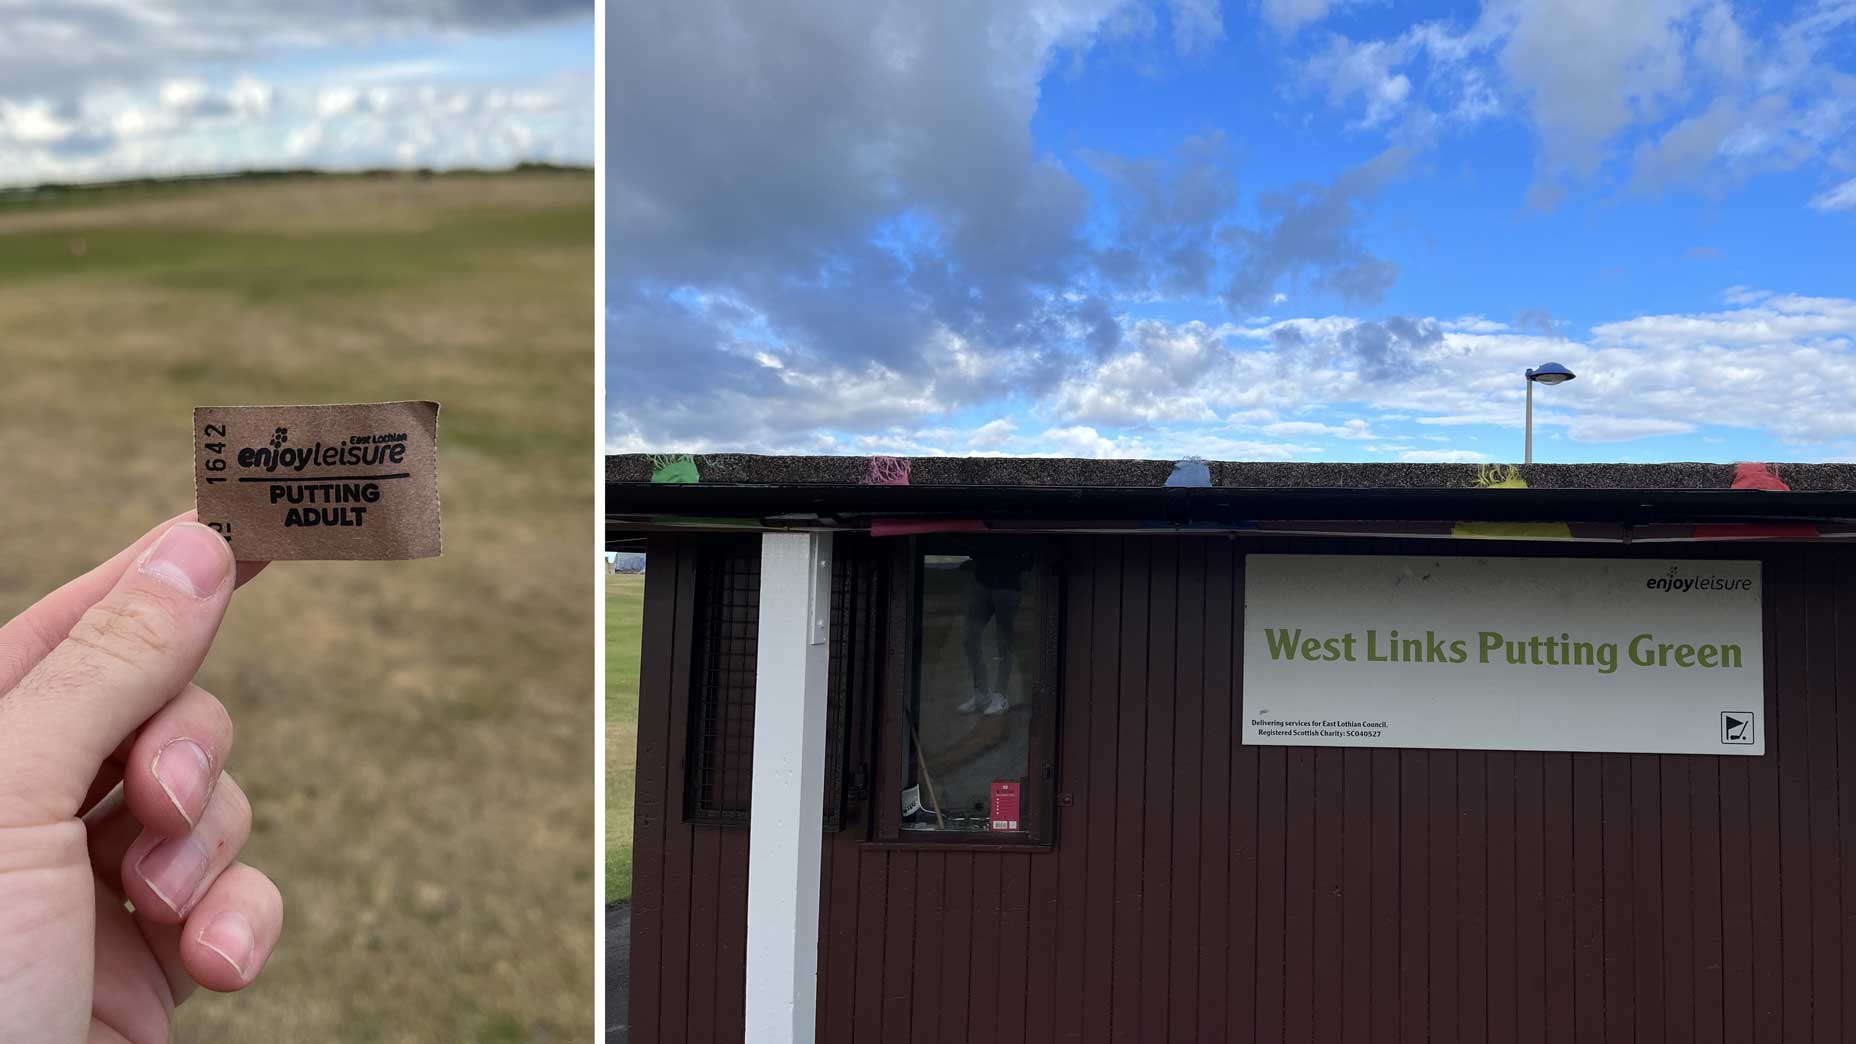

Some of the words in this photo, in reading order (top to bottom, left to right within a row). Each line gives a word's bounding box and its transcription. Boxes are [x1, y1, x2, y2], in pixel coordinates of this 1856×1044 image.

[350, 434, 371, 444] East
[373, 433, 408, 443] Lothian
[205, 424, 226, 485] 1642
[237, 441, 407, 472] enjoyleisure
[270, 483, 380, 504] PUTTING
[285, 507, 367, 527] ADULT
[1647, 575, 1752, 592] enjoyleisure
[1264, 628, 1357, 661] West
[1366, 629, 1468, 663] Links
[1478, 631, 1618, 674] Putting
[1628, 634, 1743, 668] Green
[1251, 719, 1284, 727] Delivering
[1337, 720, 1362, 728] Lothian
[1258, 729, 1292, 737] Registered
[1320, 729, 1346, 738] Charity:
[1346, 730, 1381, 738] SC040527
